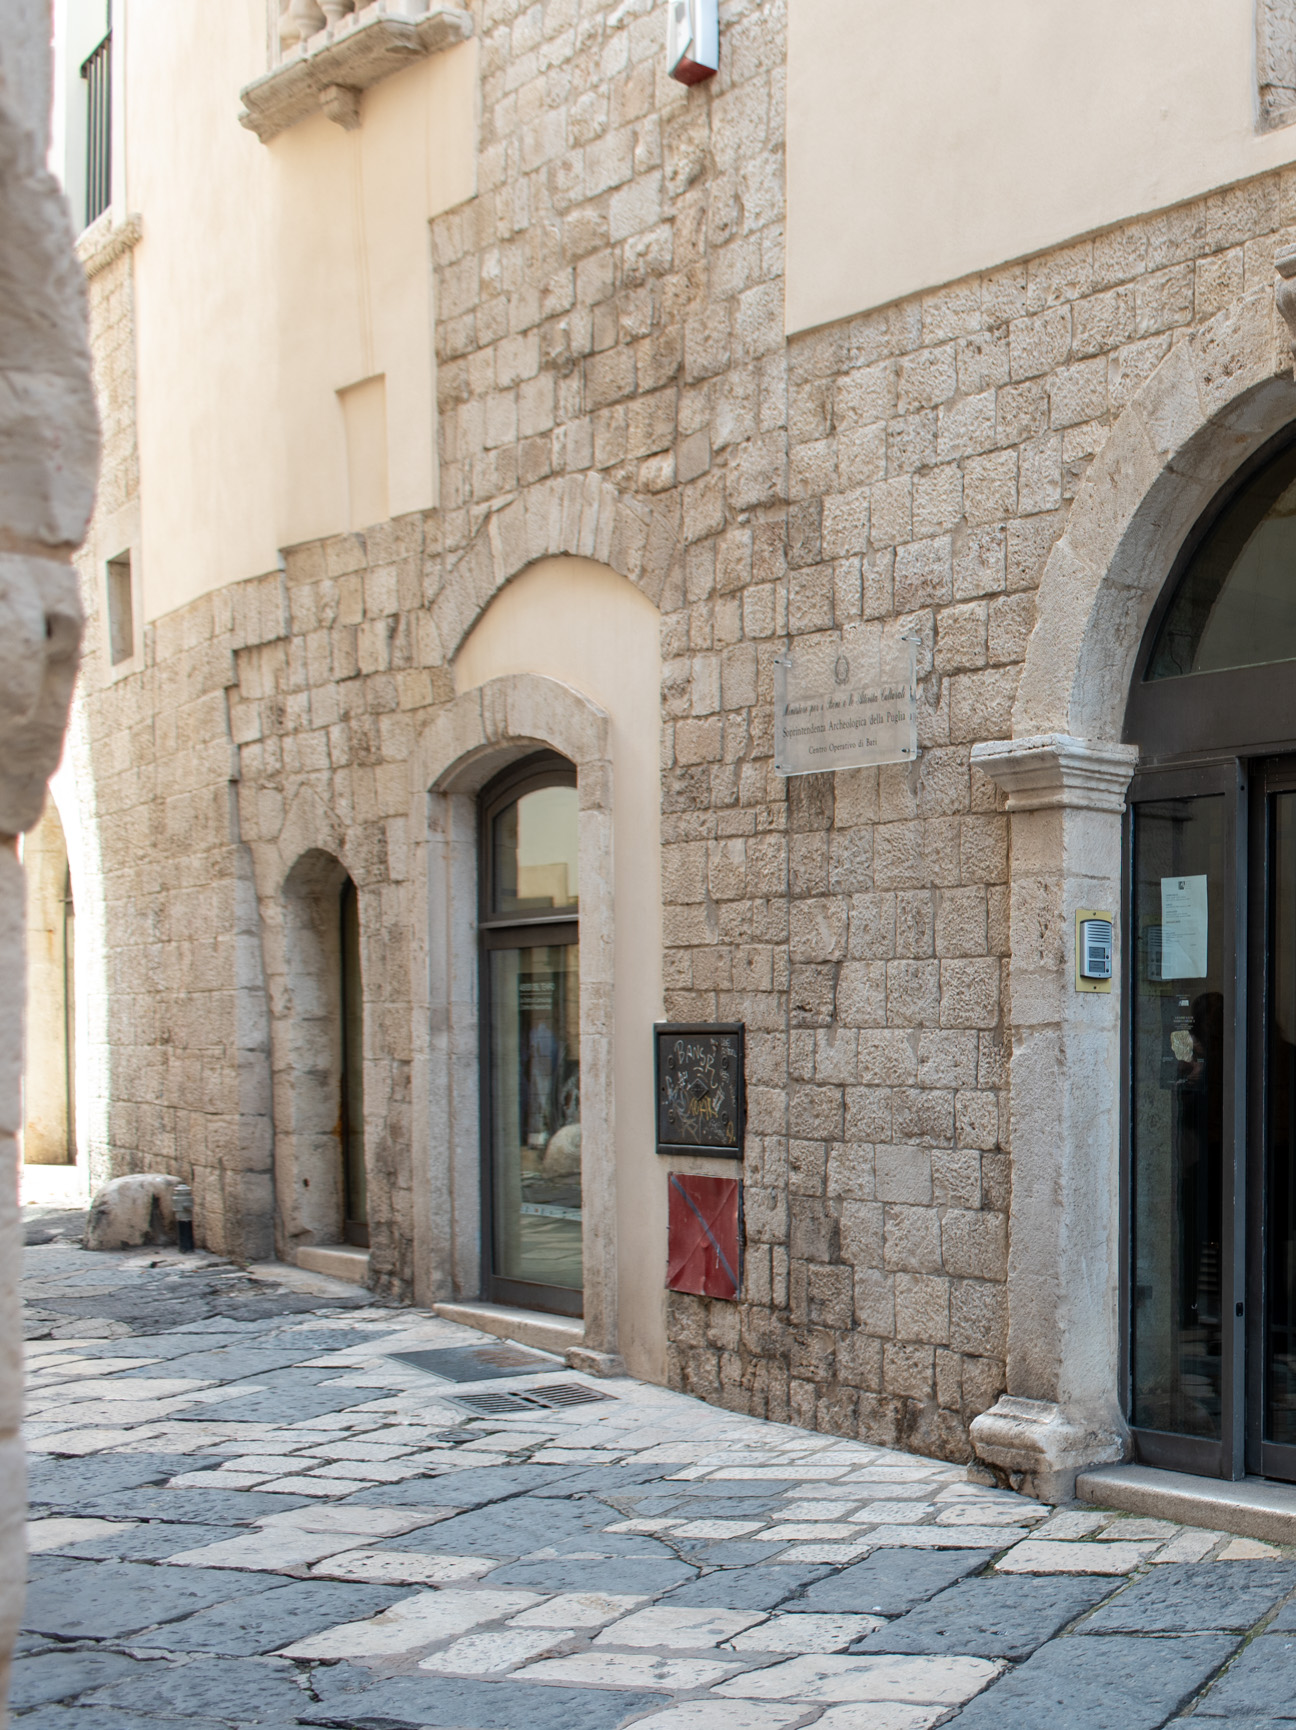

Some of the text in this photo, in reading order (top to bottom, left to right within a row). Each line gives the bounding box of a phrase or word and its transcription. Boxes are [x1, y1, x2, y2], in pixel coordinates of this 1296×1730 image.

[782, 710, 906, 739] Soprintendenza Archeologica della Puglia
[808, 737, 878, 754] Centro Operativo di Bari
